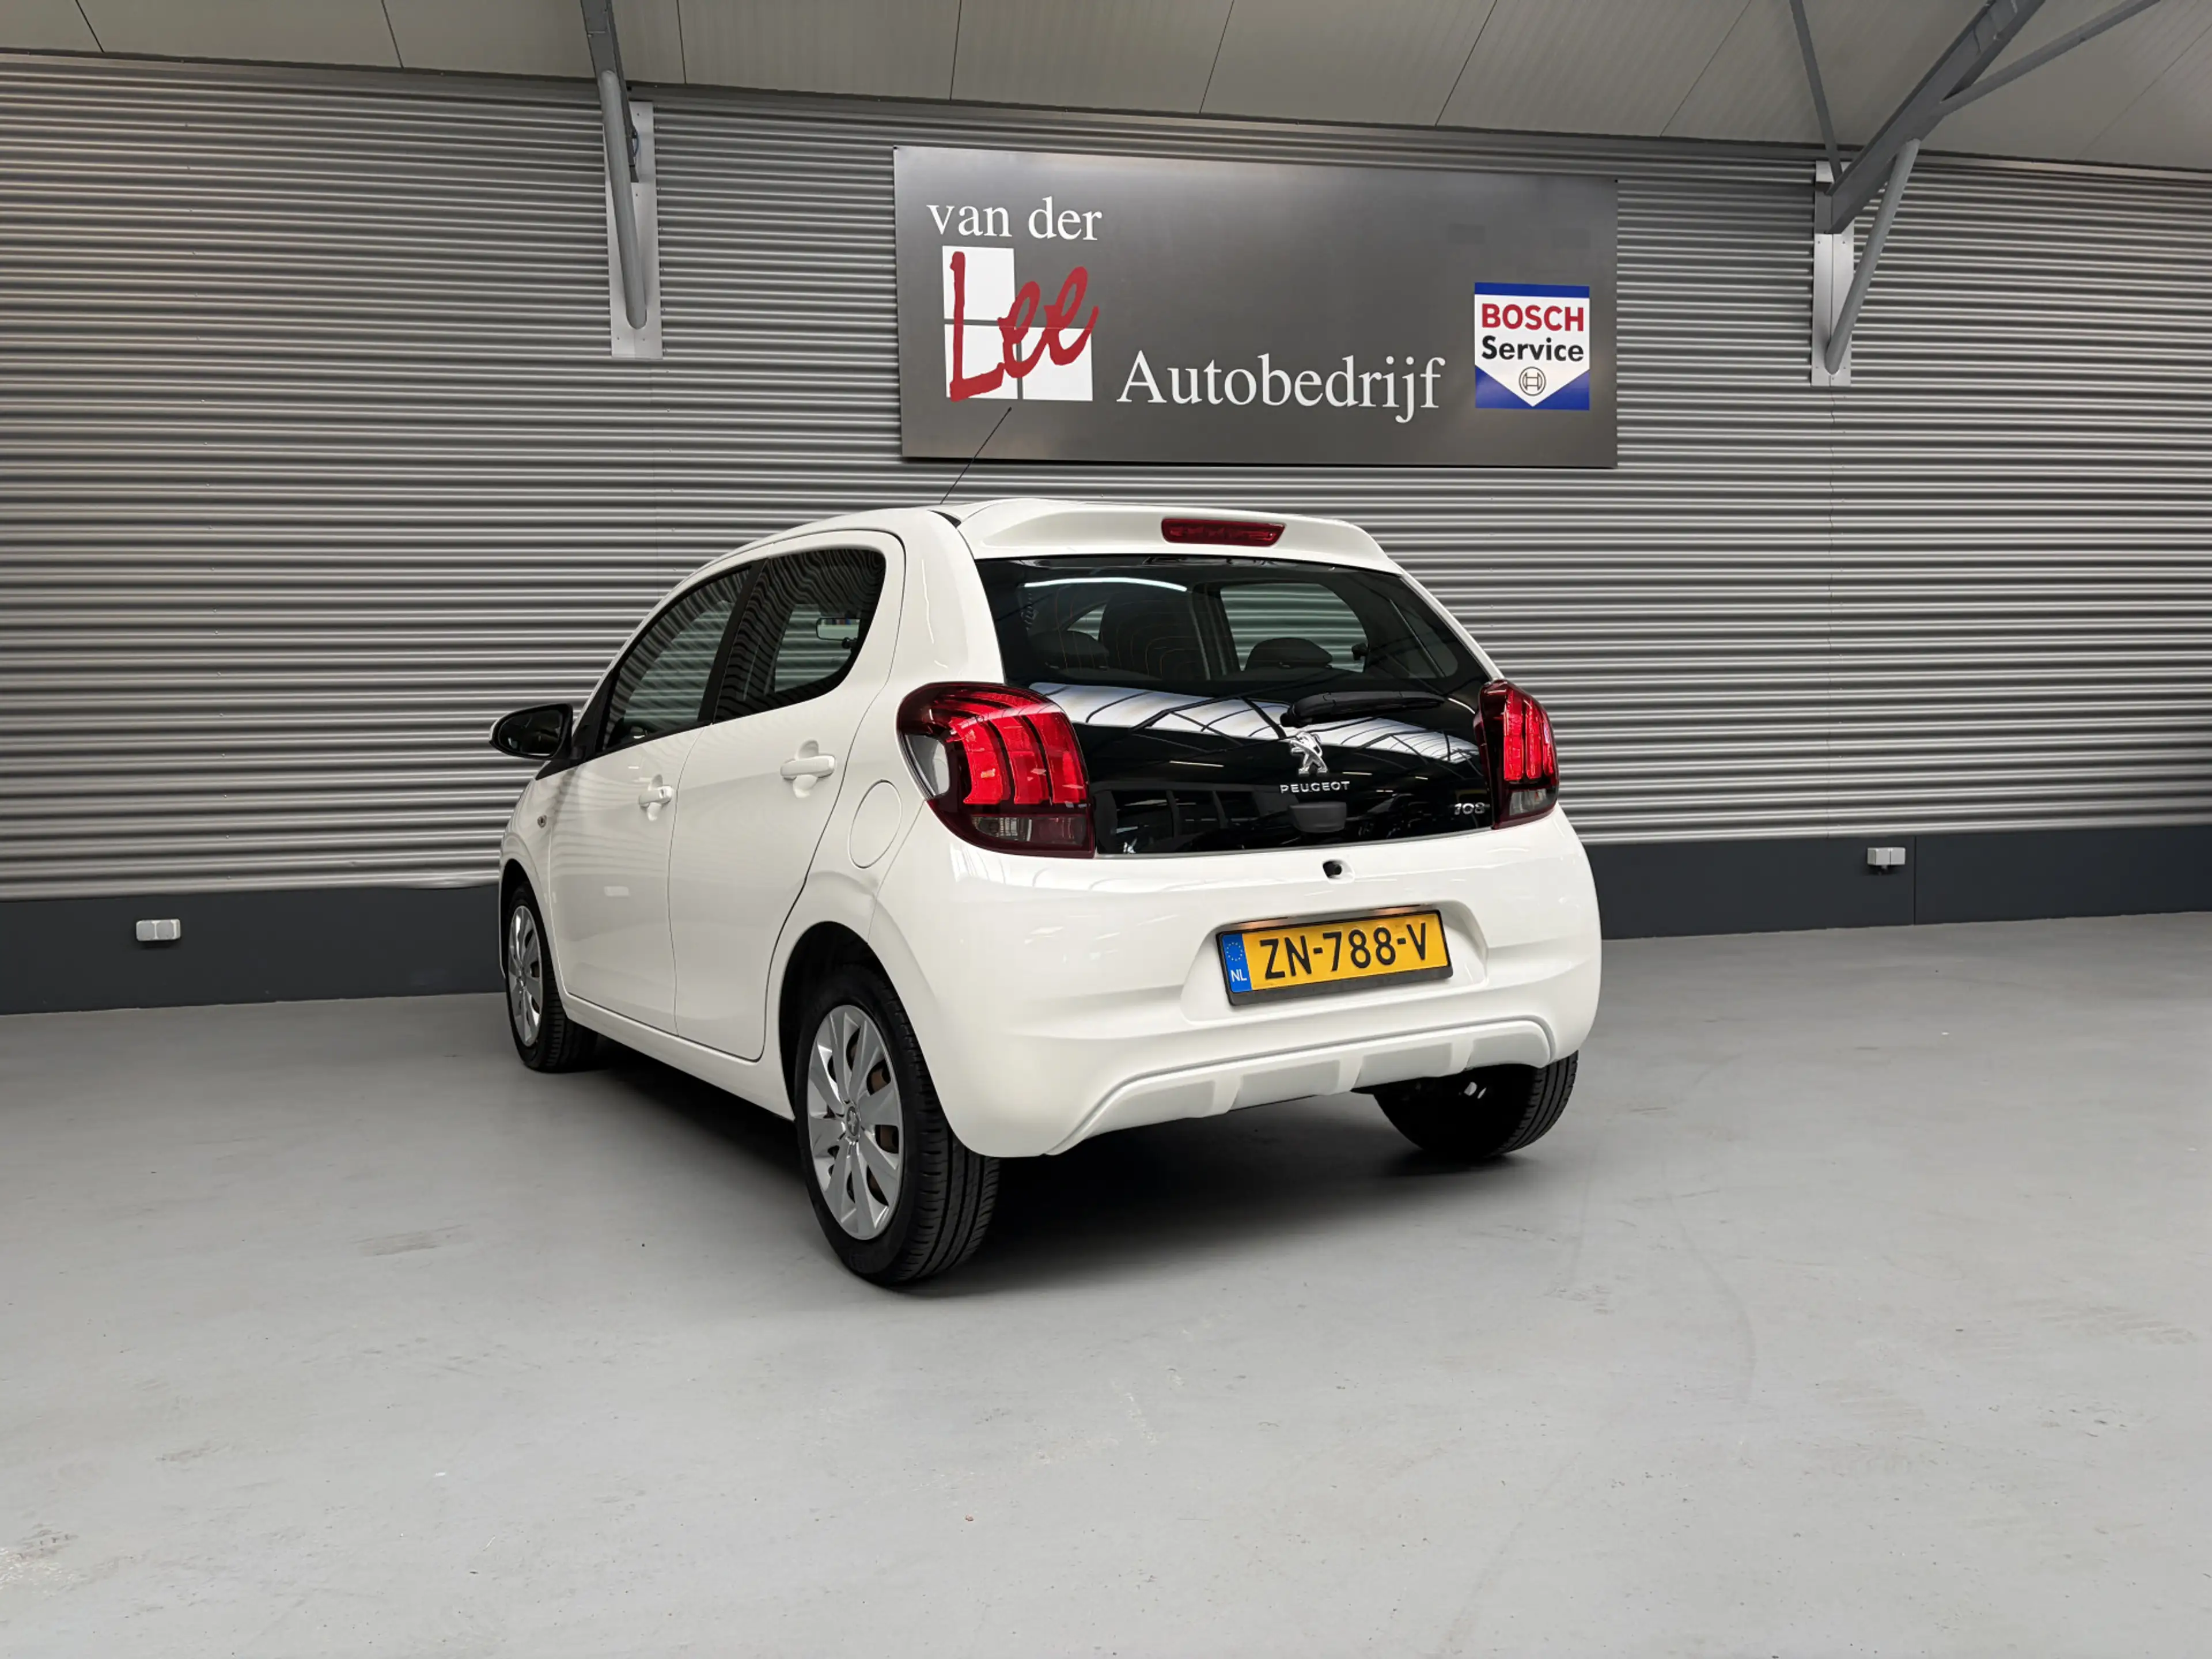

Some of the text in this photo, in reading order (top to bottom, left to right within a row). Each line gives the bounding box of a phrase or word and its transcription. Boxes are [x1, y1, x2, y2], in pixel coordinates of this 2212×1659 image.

[927, 195, 1103, 241] van der
[949, 251, 1099, 402] Lee
[1482, 303, 1584, 331] BOSCH
[1482, 335, 1584, 362] Service
[1117, 350, 1445, 423] Autobedrijf
[1280, 781, 1350, 794] PEUGEOT
[1454, 802, 1486, 815] 108
[1259, 922, 1426, 980] ZN-788-V
[1230, 969, 1247, 982] NL
